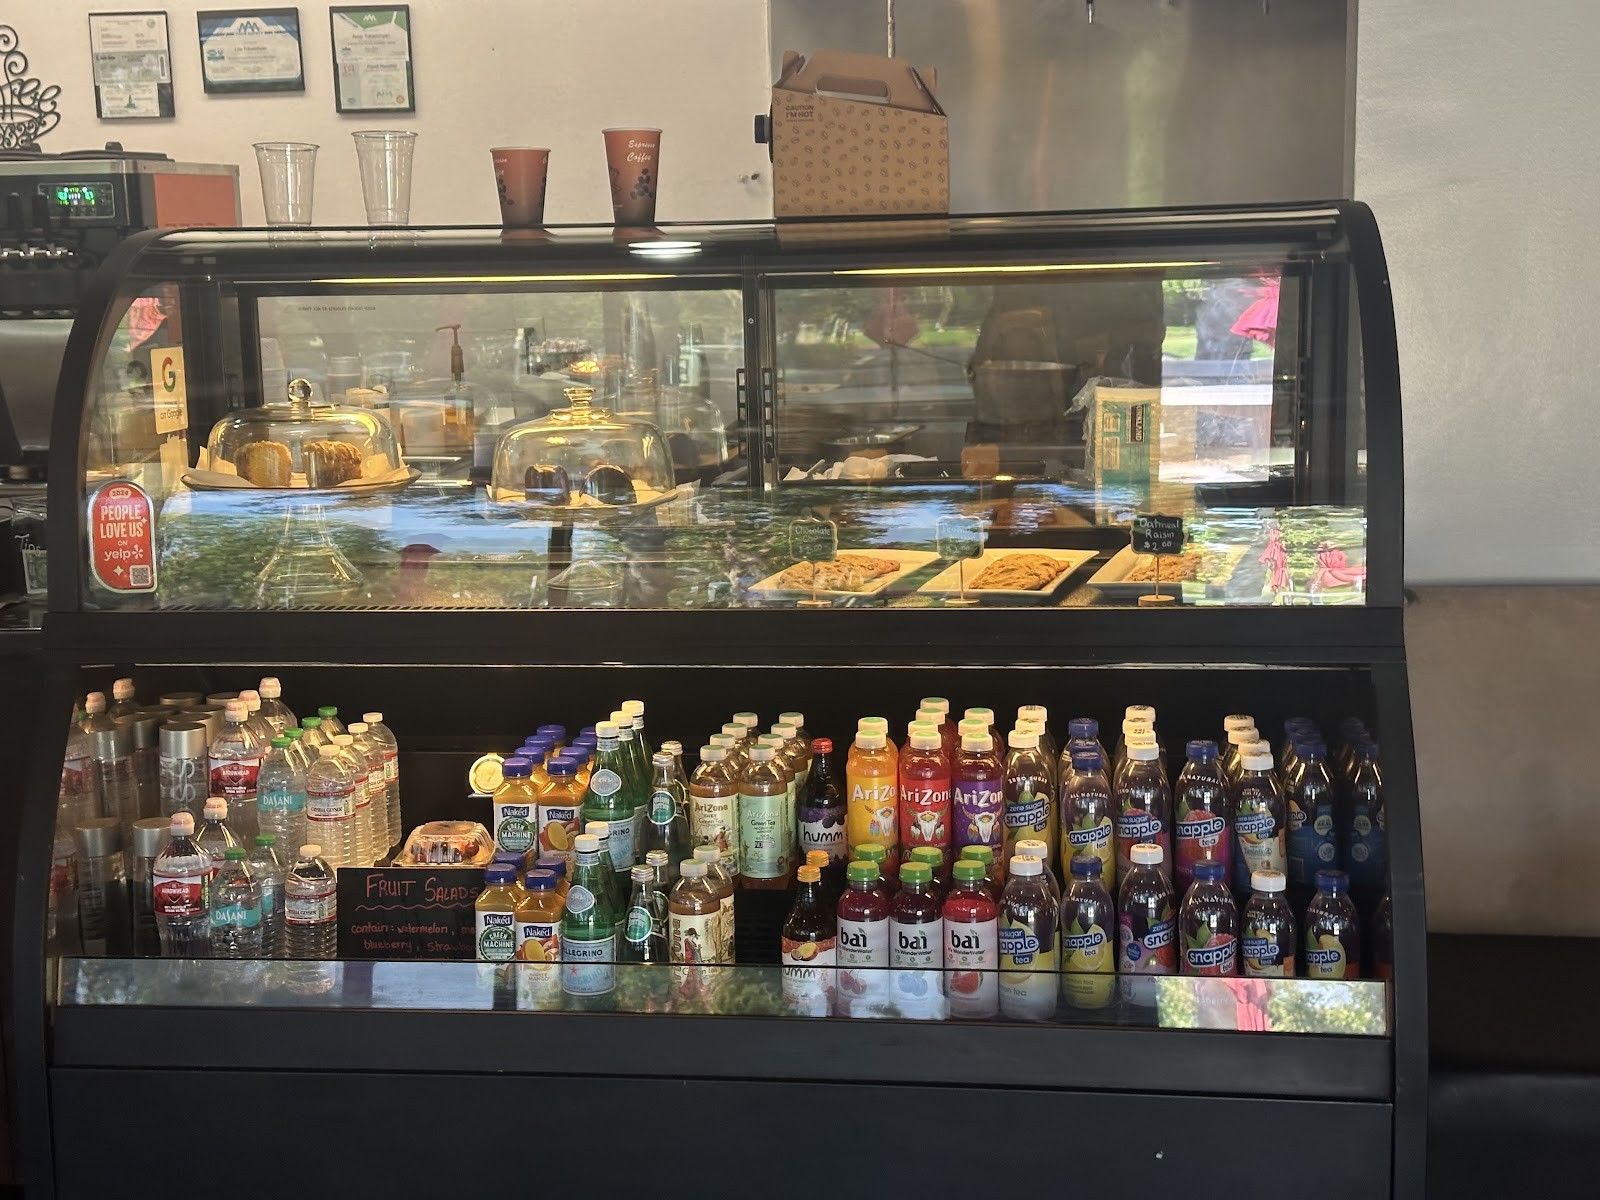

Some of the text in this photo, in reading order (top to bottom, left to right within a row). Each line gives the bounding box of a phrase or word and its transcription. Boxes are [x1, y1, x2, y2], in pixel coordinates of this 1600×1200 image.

[628, 139, 656, 149] Espresso
[626, 152, 651, 162] Coffee
[166, 408, 183, 420] Google
[101, 504, 142, 520] PEOPLE
[1140, 517, 1179, 529] Oatmeal
[100, 521, 144, 539] LOVE US
[1145, 528, 1175, 539] Raisin
[104, 548, 131, 562] yelp
[263, 795, 293, 806] DASANI
[503, 807, 528, 817] Naked
[695, 802, 729, 813] AriZona
[549, 811, 572, 820] Naked
[1006, 803, 1050, 826] snapple
[501, 831, 531, 839] MACHINE
[803, 824, 843, 842] humm
[1070, 824, 1111, 844] snapple
[1096, 841, 1107, 849] tea
[1201, 838, 1216, 846] tea
[366, 873, 479, 902] FRUIT SALADS
[215, 910, 247, 921] DASANI
[486, 915, 511, 925] Naked
[488, 931, 508, 940] GREEN
[526, 927, 550, 936] Naked
[840, 927, 867, 948] bai
[898, 930, 928, 950] bai
[951, 929, 980, 949] bai
[483, 940, 514, 948] MACHINE
[1084, 949, 1097, 957] tea
[1189, 940, 1237, 966] snapple
[1015, 955, 1030, 964] tea
[1320, 966, 1333, 974] tea
